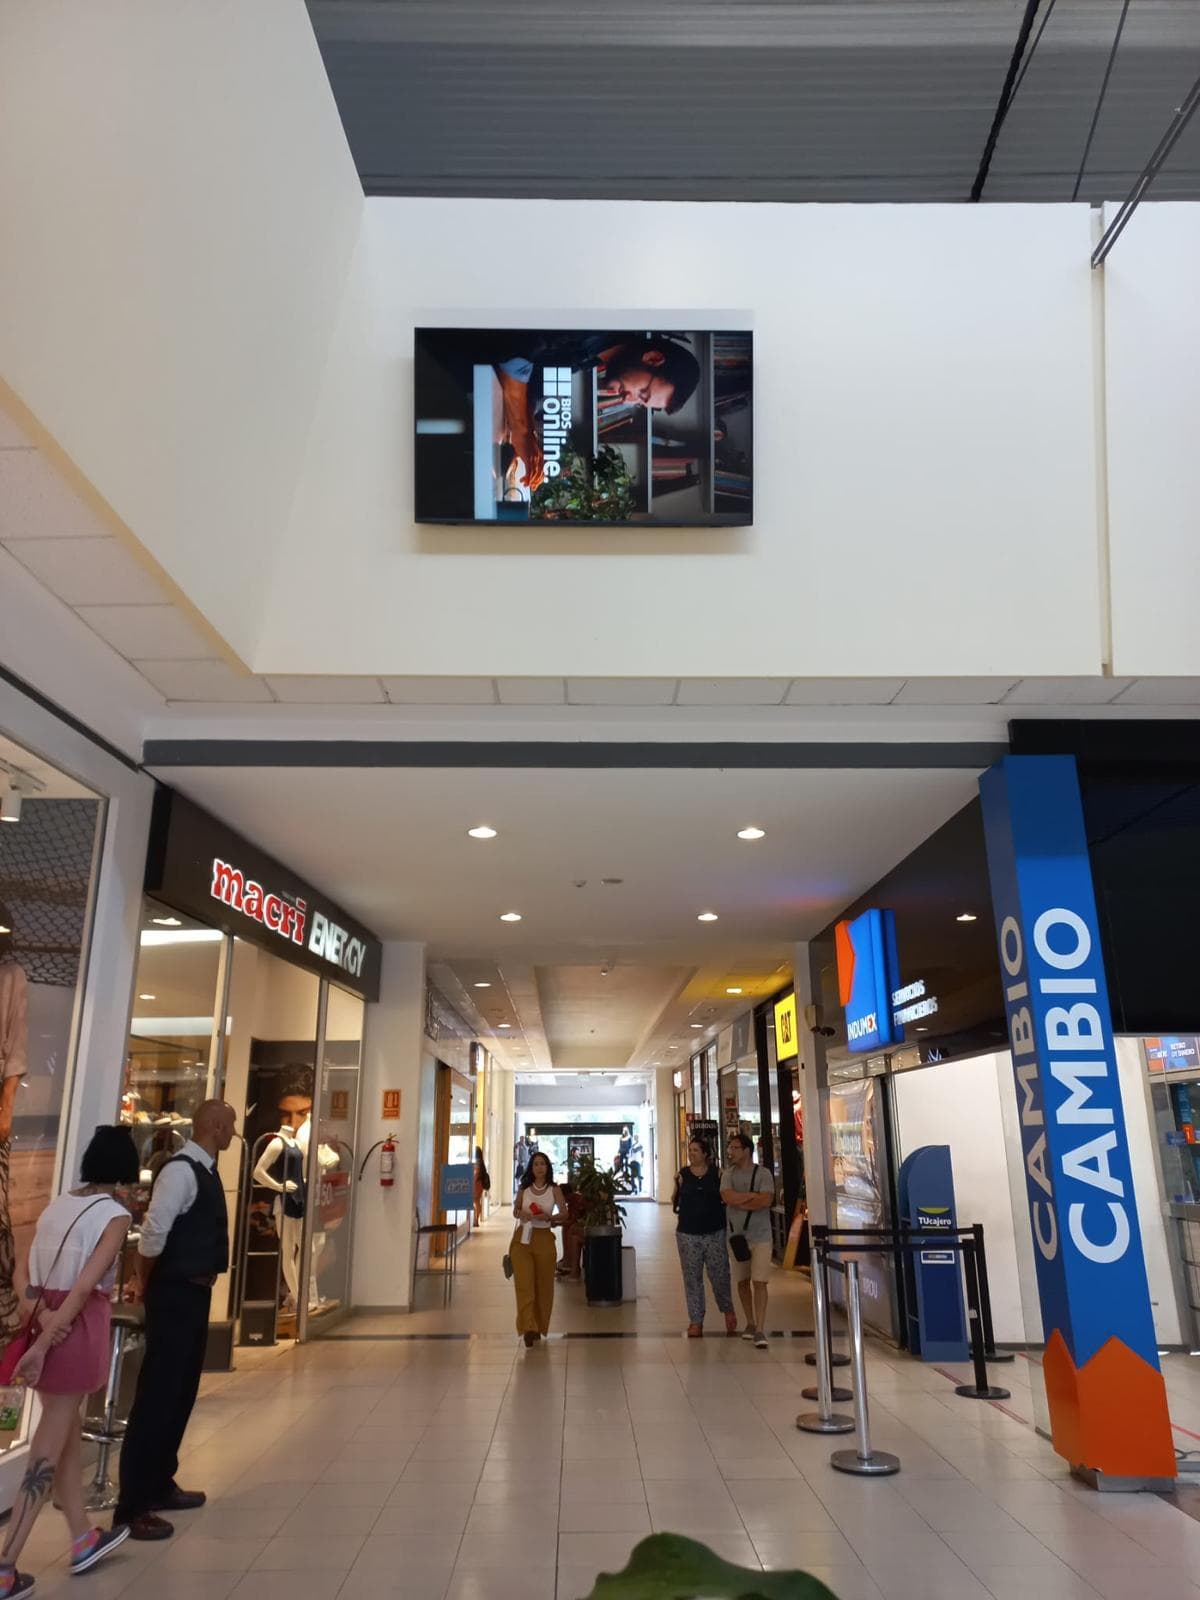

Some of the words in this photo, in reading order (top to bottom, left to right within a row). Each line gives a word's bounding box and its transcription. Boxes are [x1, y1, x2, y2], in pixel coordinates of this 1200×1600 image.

[542, 397, 567, 484] online.
[561, 397, 572, 428] BIOS
[210, 857, 307, 945] macri
[780, 1010, 792, 1044] CAT
[846, 1012, 878, 1041] INDUMEX
[1000, 914, 1060, 1261] CAMBIO
[1033, 907, 1131, 1264] CAMBIO
[917, 1216, 952, 1227] TUcajero
